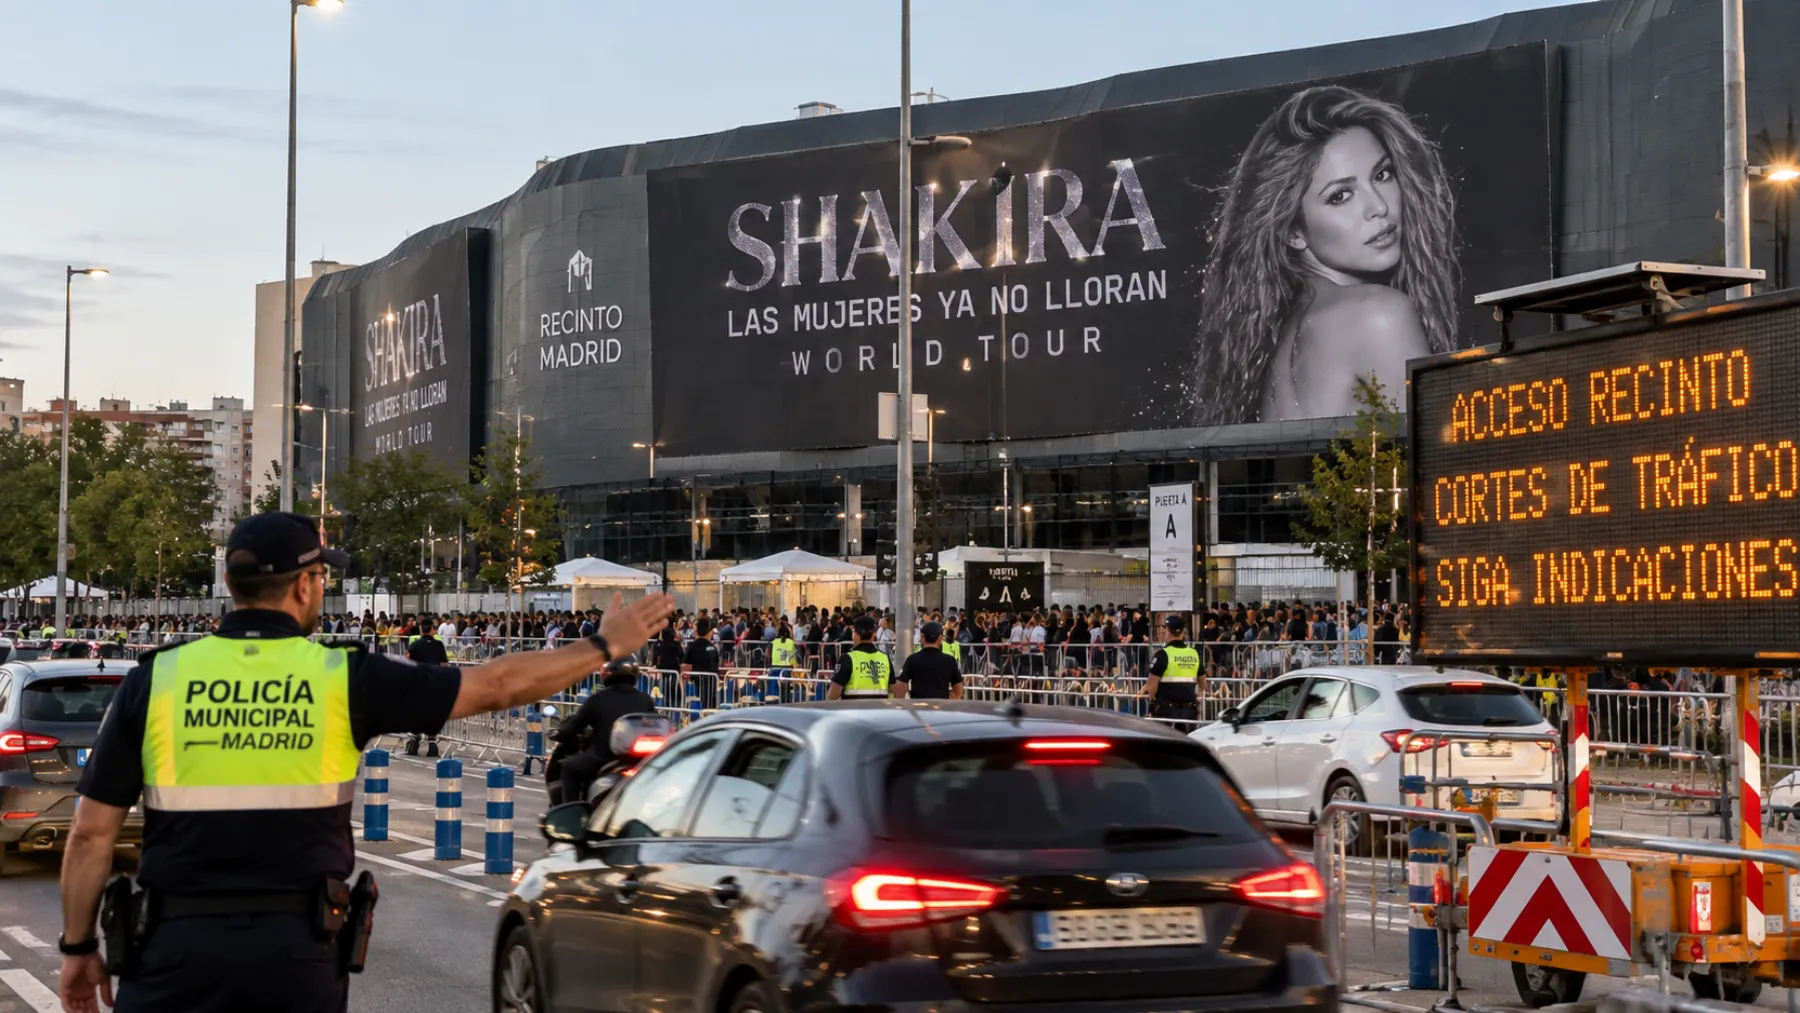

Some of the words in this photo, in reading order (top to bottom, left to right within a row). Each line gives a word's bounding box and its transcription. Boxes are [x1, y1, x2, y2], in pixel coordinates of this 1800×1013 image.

[726, 158, 1166, 291] SHAKIRA
[540, 305, 622, 338] RECINTO
[728, 306, 778, 337] LAS
[793, 294, 921, 332] MUJERES
[938, 289, 975, 319] YA
[991, 284, 1028, 314] NO
[1046, 270, 1167, 310] LLORAN
[365, 293, 447, 392] SHAKIRA
[540, 338, 622, 371] MADRID
[792, 340, 943, 375] WORLD
[978, 326, 1102, 359] TOUR
[1452, 377, 1568, 444] ACCESO
[1590, 349, 1750, 425] RECINTO
[408, 422, 432, 446] TOUR
[1435, 467, 1547, 526] CORTES
[1569, 460, 1610, 515] DE
[1632, 436, 1798, 510] TRÁFICO
[1165, 513, 1177, 539] A
[1437, 556, 1510, 607] SIGA
[1533, 538, 1798, 604] INDICACIONES
[185, 674, 315, 704] POLICÍA
[184, 708, 315, 728] MUNICIPAL
[221, 732, 314, 750] MADRID
